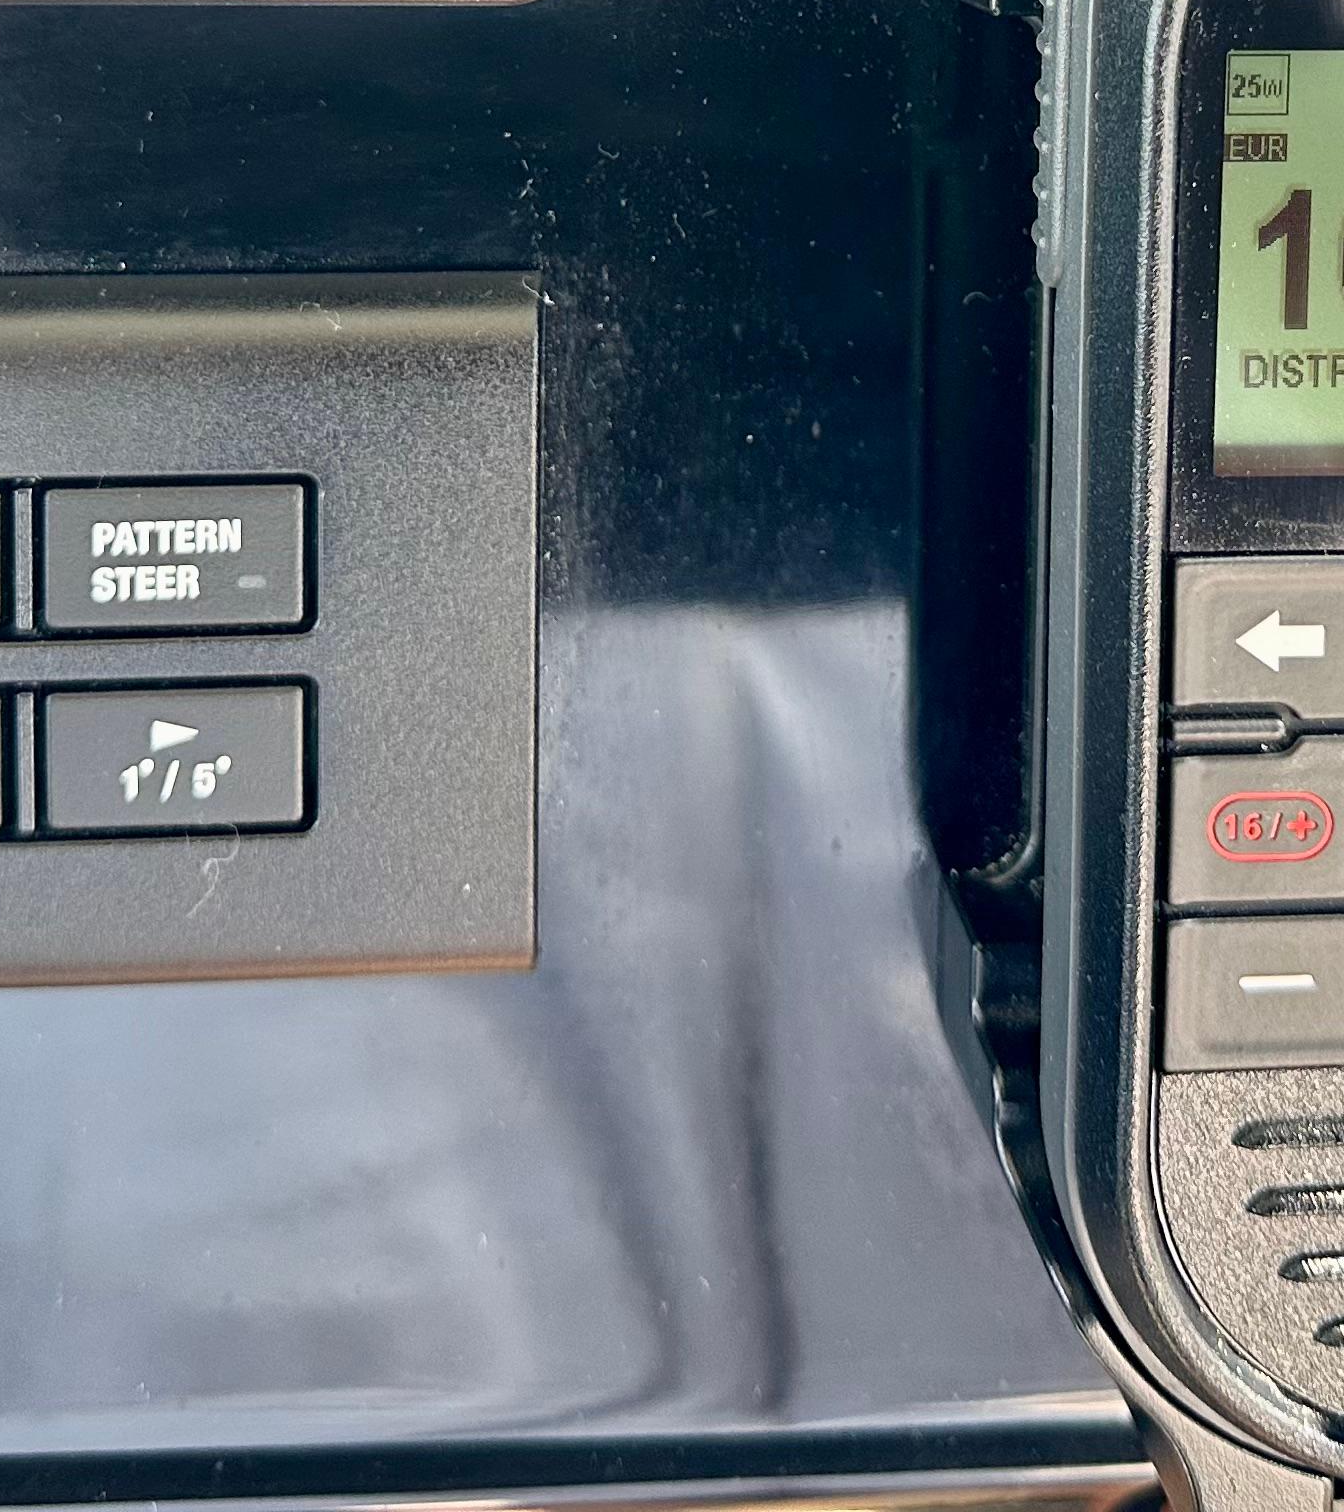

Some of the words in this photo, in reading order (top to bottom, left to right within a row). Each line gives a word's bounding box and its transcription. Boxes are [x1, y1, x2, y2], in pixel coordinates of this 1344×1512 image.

[1228, 135, 1286, 161] EUR
[89, 519, 243, 560] PATTERN
[90, 564, 201, 602] STEER
